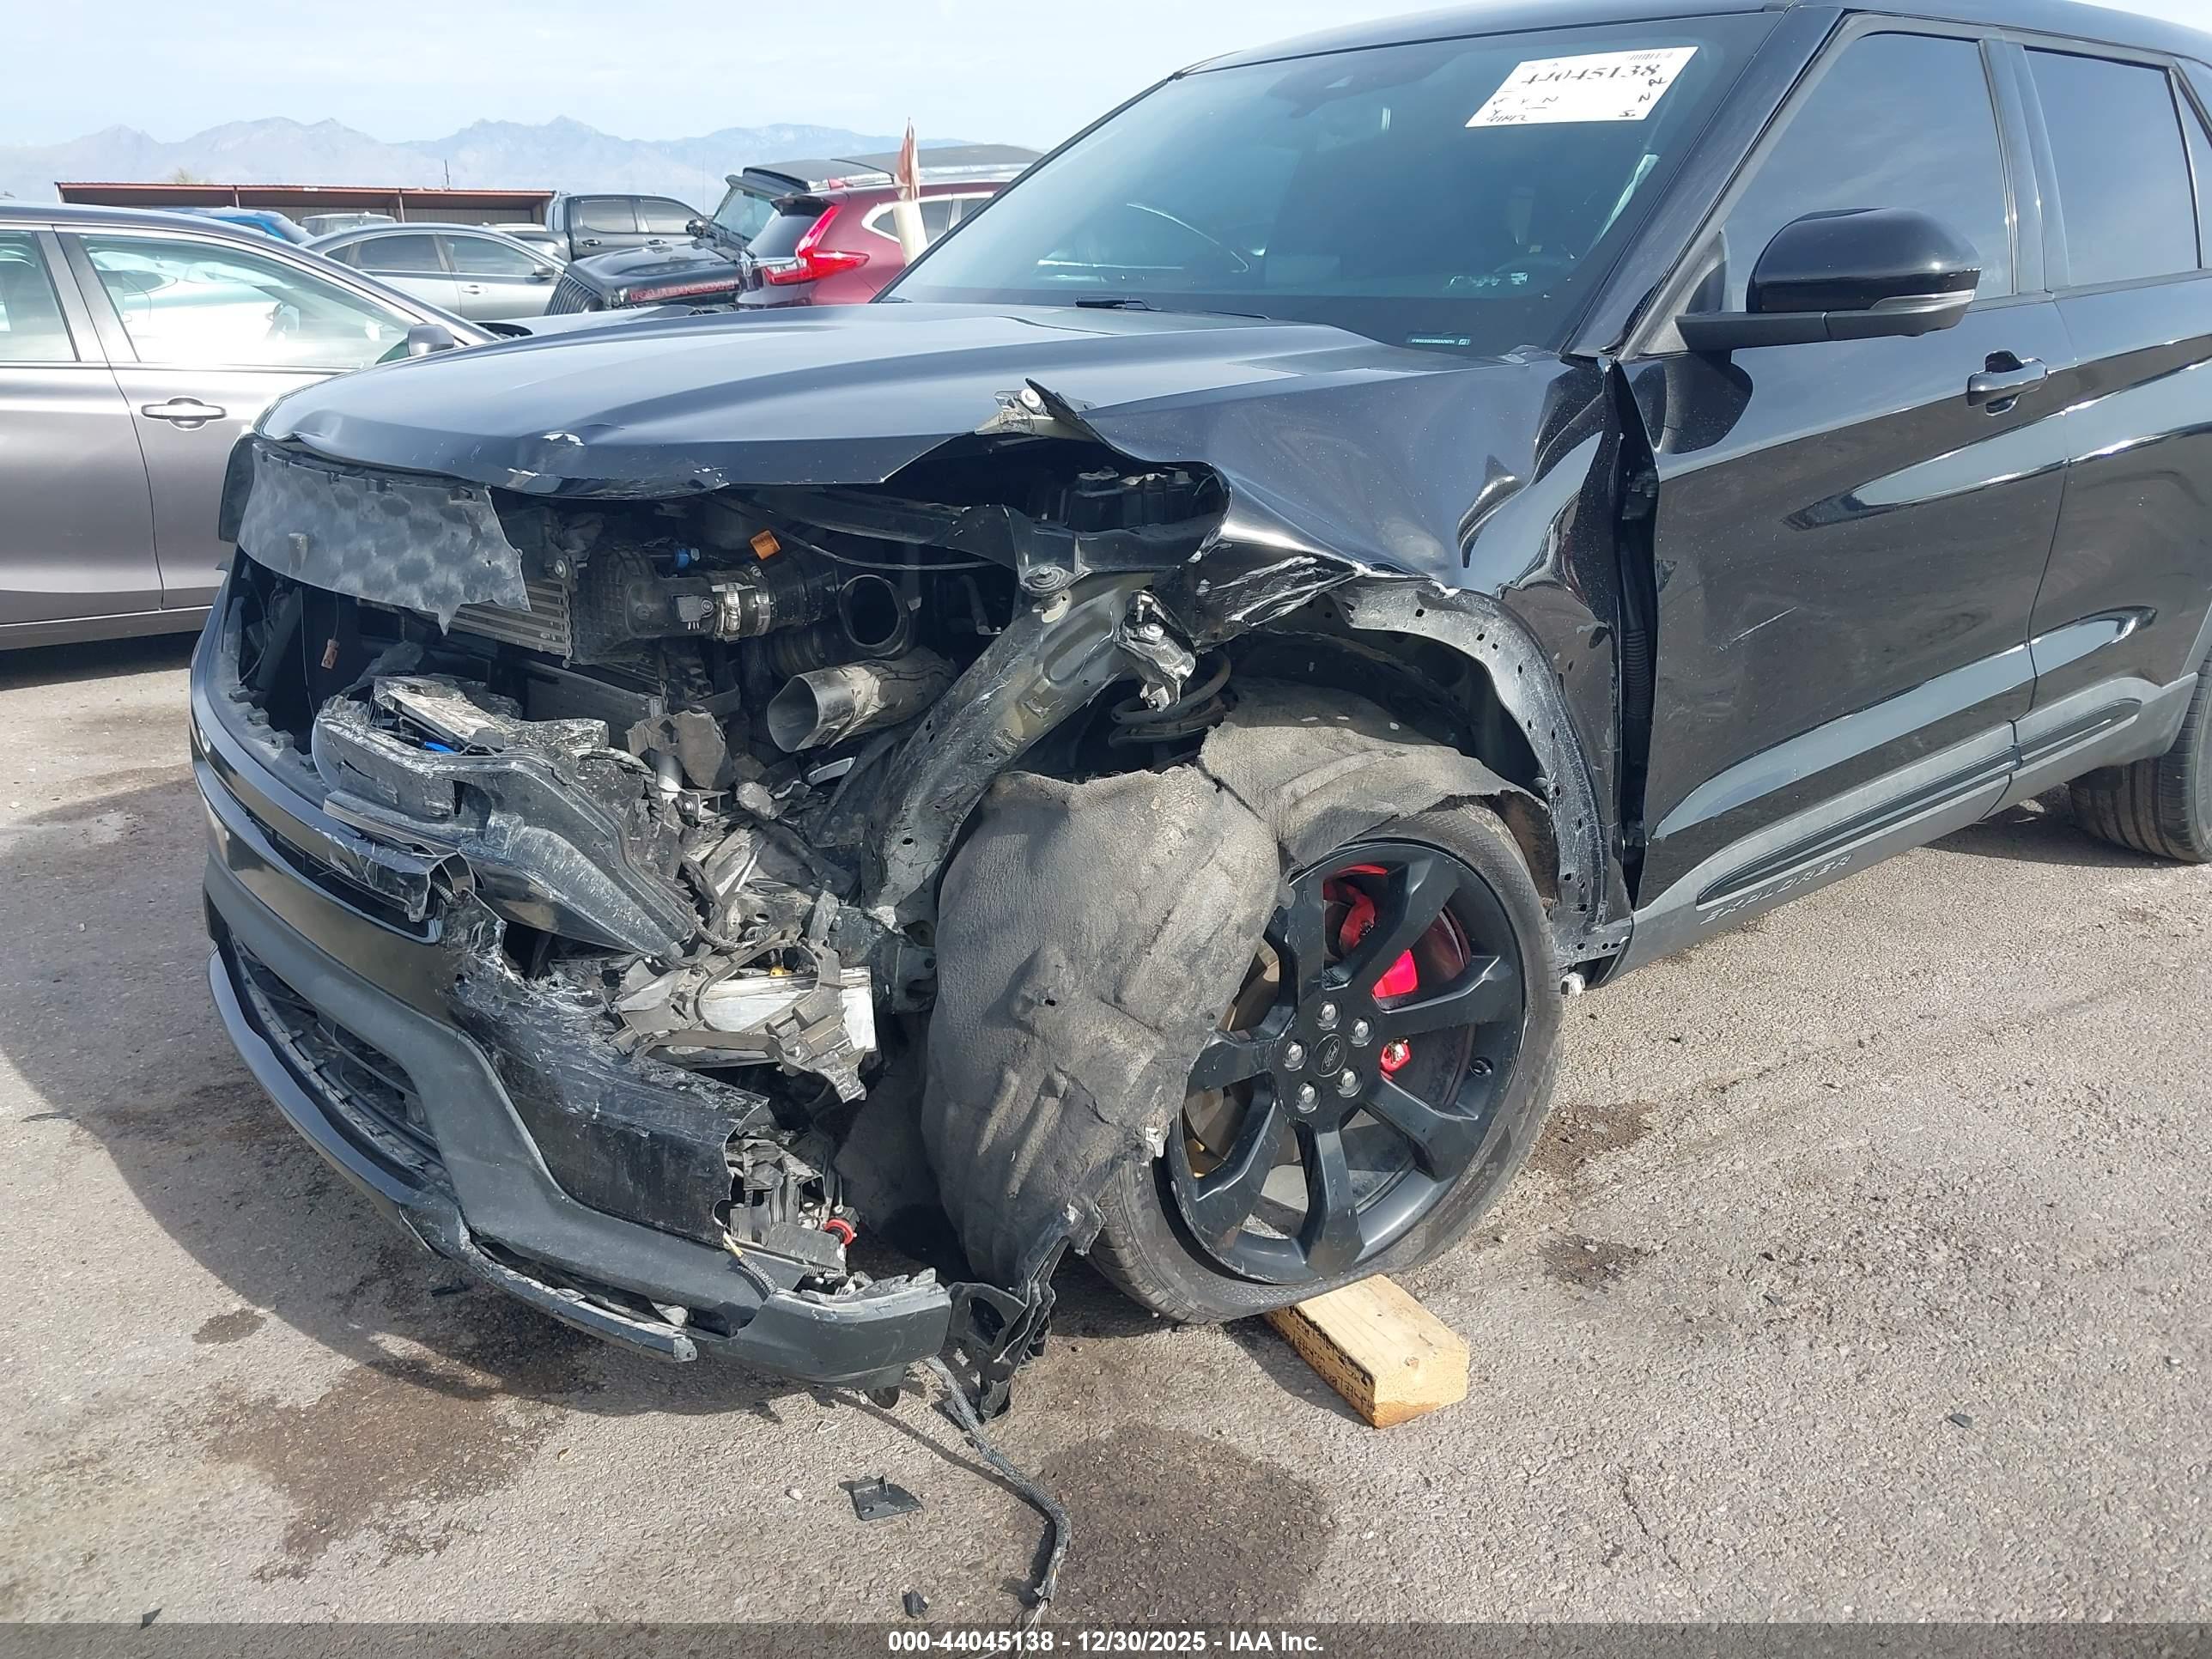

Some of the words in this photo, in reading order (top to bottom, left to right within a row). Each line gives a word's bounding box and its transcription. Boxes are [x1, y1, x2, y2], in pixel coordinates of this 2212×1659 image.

[629, 279, 736, 302] RUBICON
[1699, 854, 1853, 927] EXPLORER
[1323, 1044, 1339, 1067] Ford
